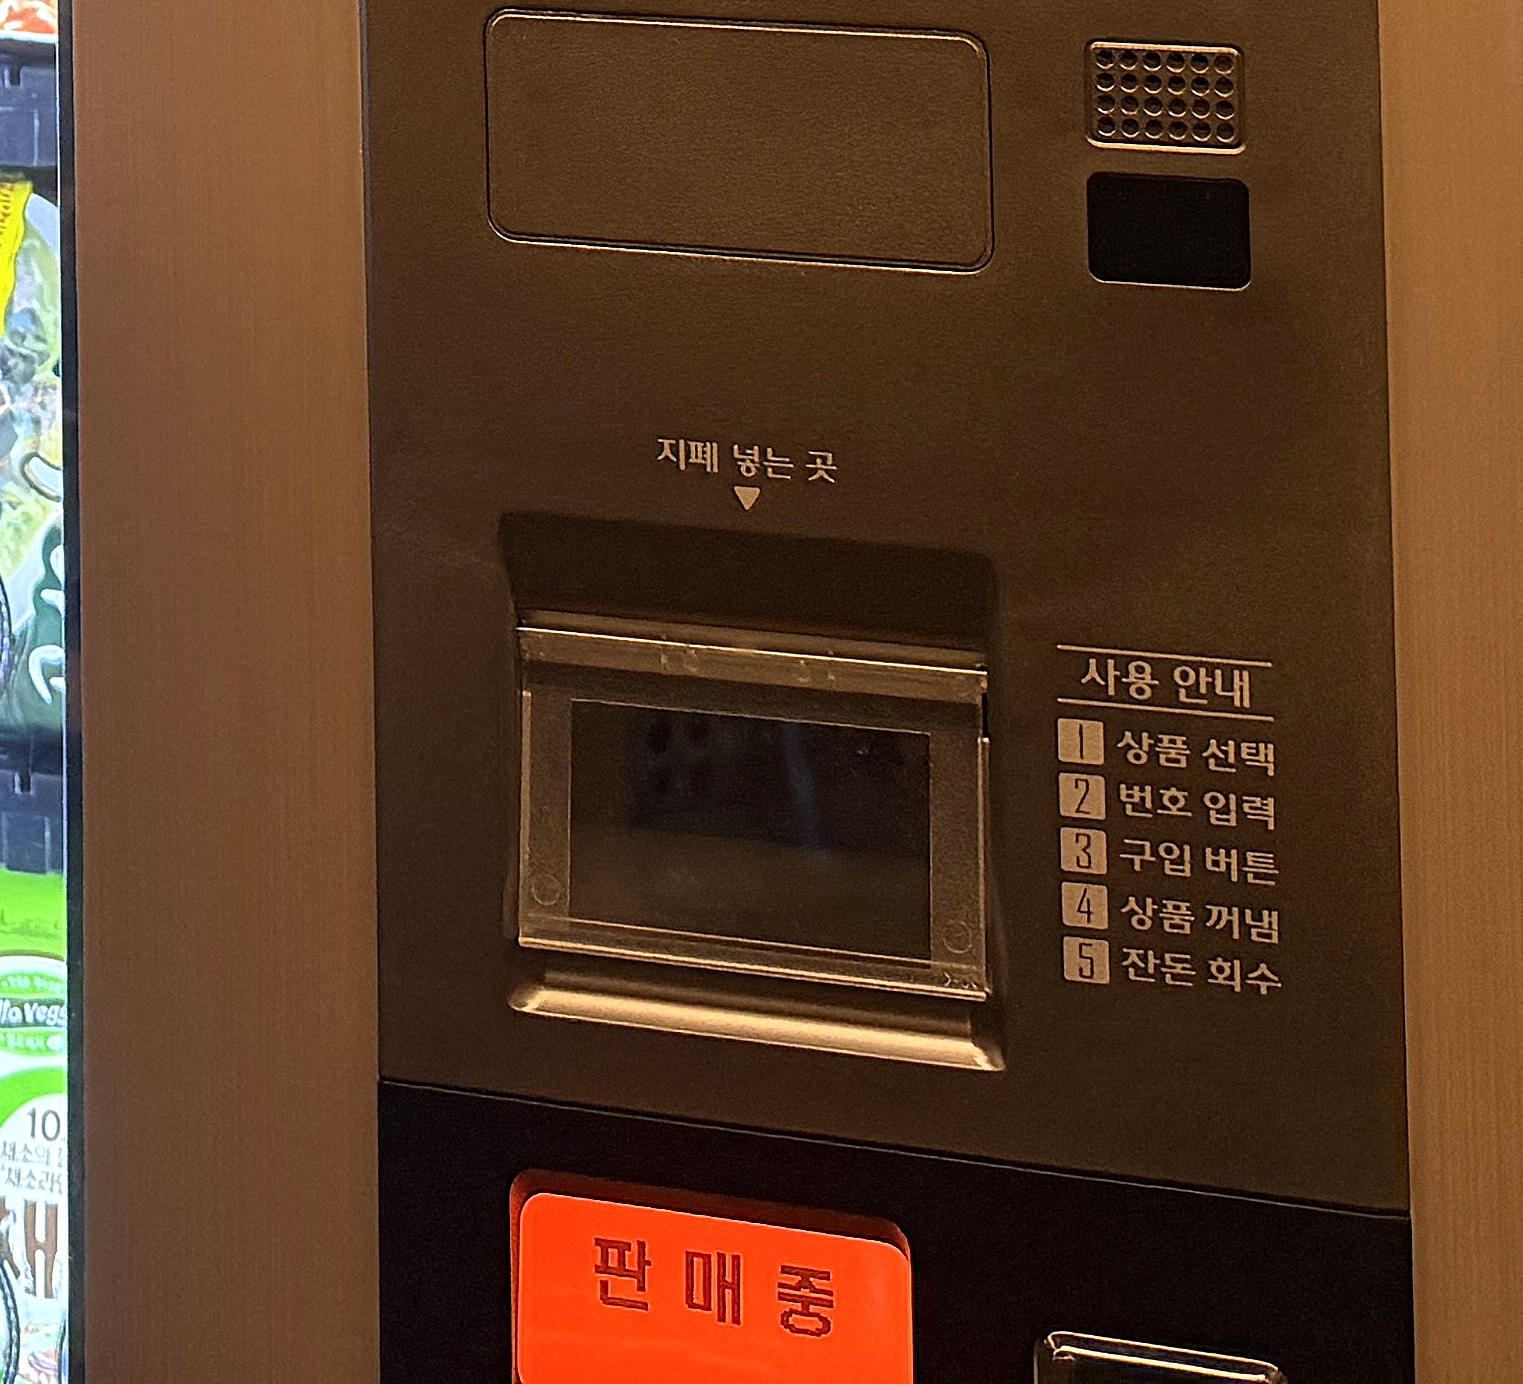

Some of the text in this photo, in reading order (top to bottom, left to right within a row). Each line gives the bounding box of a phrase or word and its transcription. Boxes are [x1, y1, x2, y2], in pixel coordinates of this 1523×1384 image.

[656, 436, 837, 484] 지폐 넣는 곳
[1080, 657, 1251, 709] 사용 안내
[1116, 730, 1192, 769] 상품
[1201, 737, 1276, 777] 선택
[1119, 783, 1193, 819] 번호
[1203, 790, 1276, 831] 입력
[1119, 838, 1192, 877] 구입
[1204, 846, 1280, 886] 버튼
[1119, 895, 1196, 935] 상품
[1205, 903, 1280, 944] 꺼냄
[1121, 947, 1197, 987] 잔돈
[1207, 956, 1282, 996] 회수
[594, 1236, 835, 1338] 판매중
